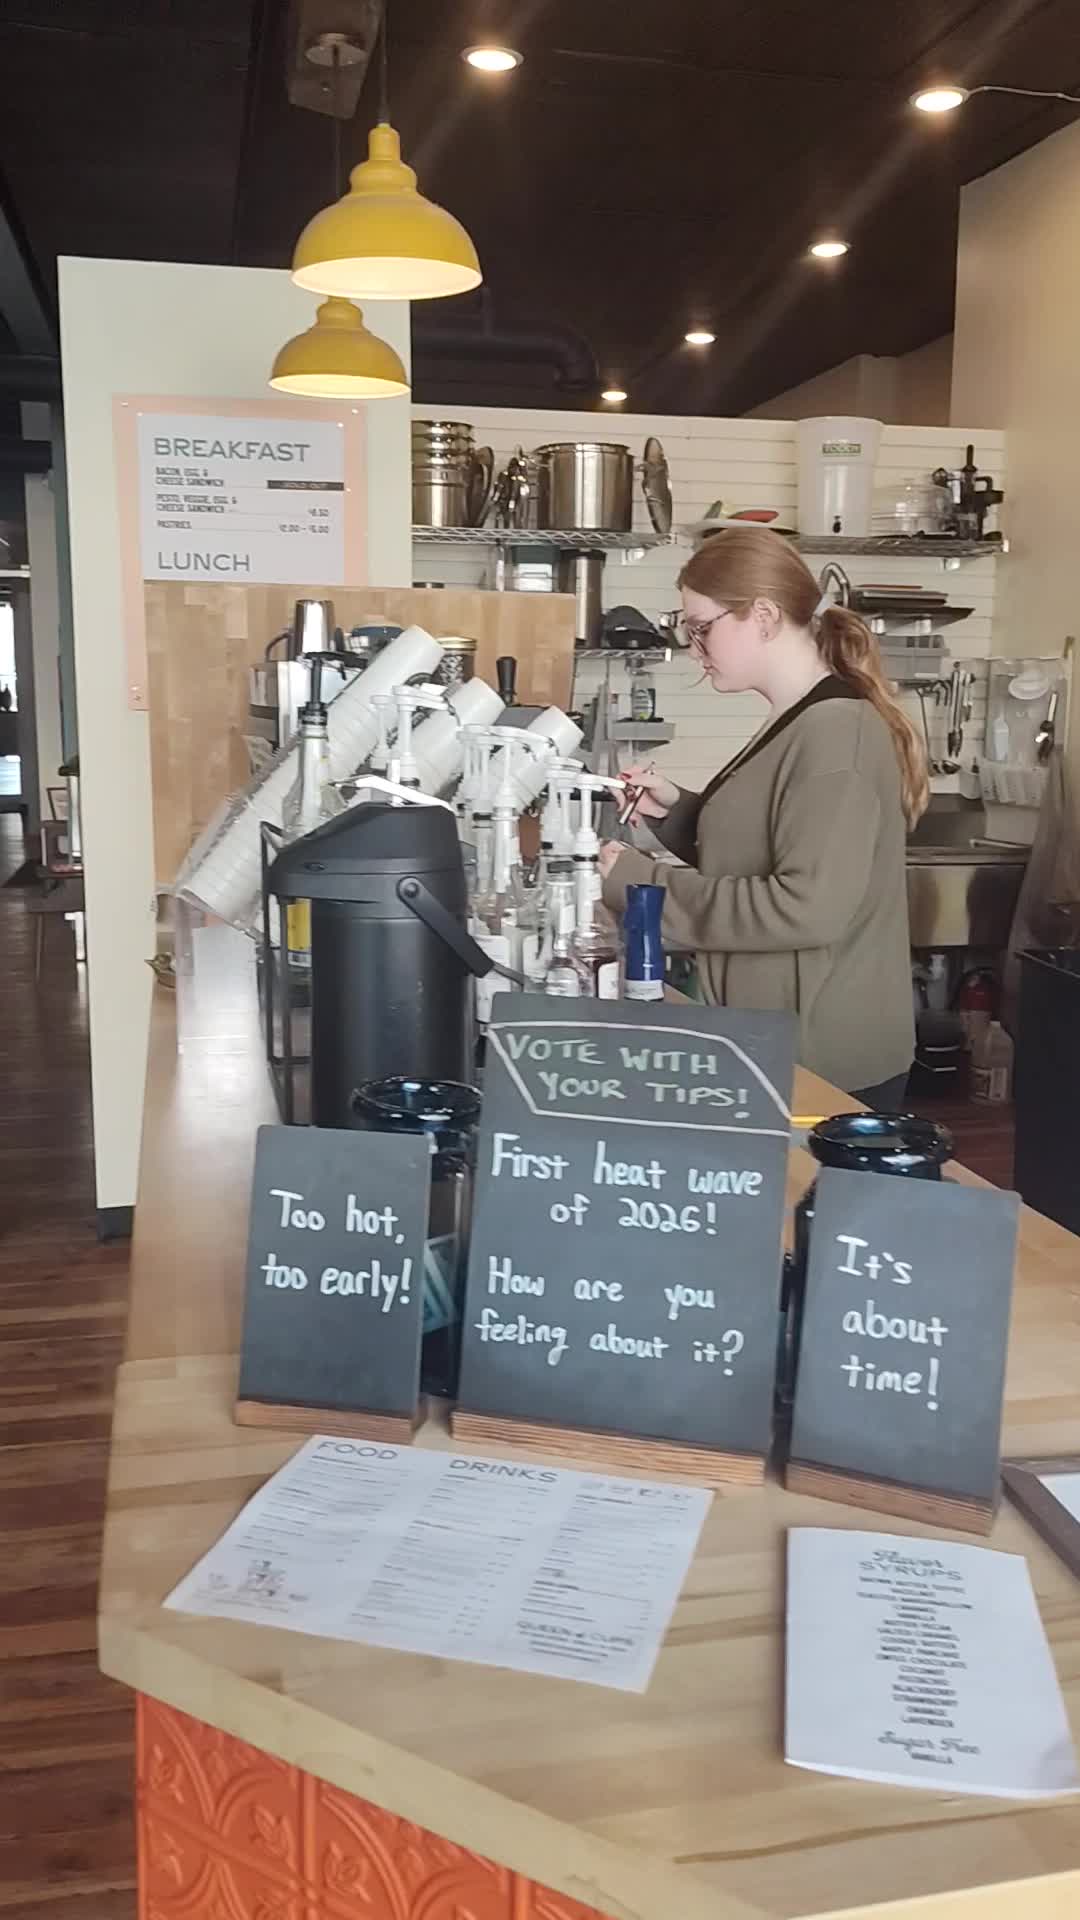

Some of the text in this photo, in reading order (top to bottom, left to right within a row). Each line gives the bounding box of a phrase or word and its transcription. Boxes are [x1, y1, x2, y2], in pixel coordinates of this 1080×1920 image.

[153, 437, 311, 463] BREAKFAST
[157, 551, 250, 572] LUNCH
[506, 1033, 718, 1075] VOTE WITH
[538, 1071, 750, 1119] YOUR TIPS!
[492, 1132, 764, 1196] First heat wave
[268, 1188, 405, 1244] Too hot,
[550, 1193, 719, 1235] of 2026!
[260, 1252, 413, 1313] too early!
[836, 1234, 913, 1285] It's
[488, 1256, 716, 1321] How are you
[475, 1308, 745, 1376] feeling about it?
[842, 1299, 950, 1347] about
[840, 1354, 940, 1411] time!
[316, 1440, 399, 1461] FOOD
[448, 1459, 558, 1484] DRINKS
[858, 1561, 963, 1581] SYRUPS
